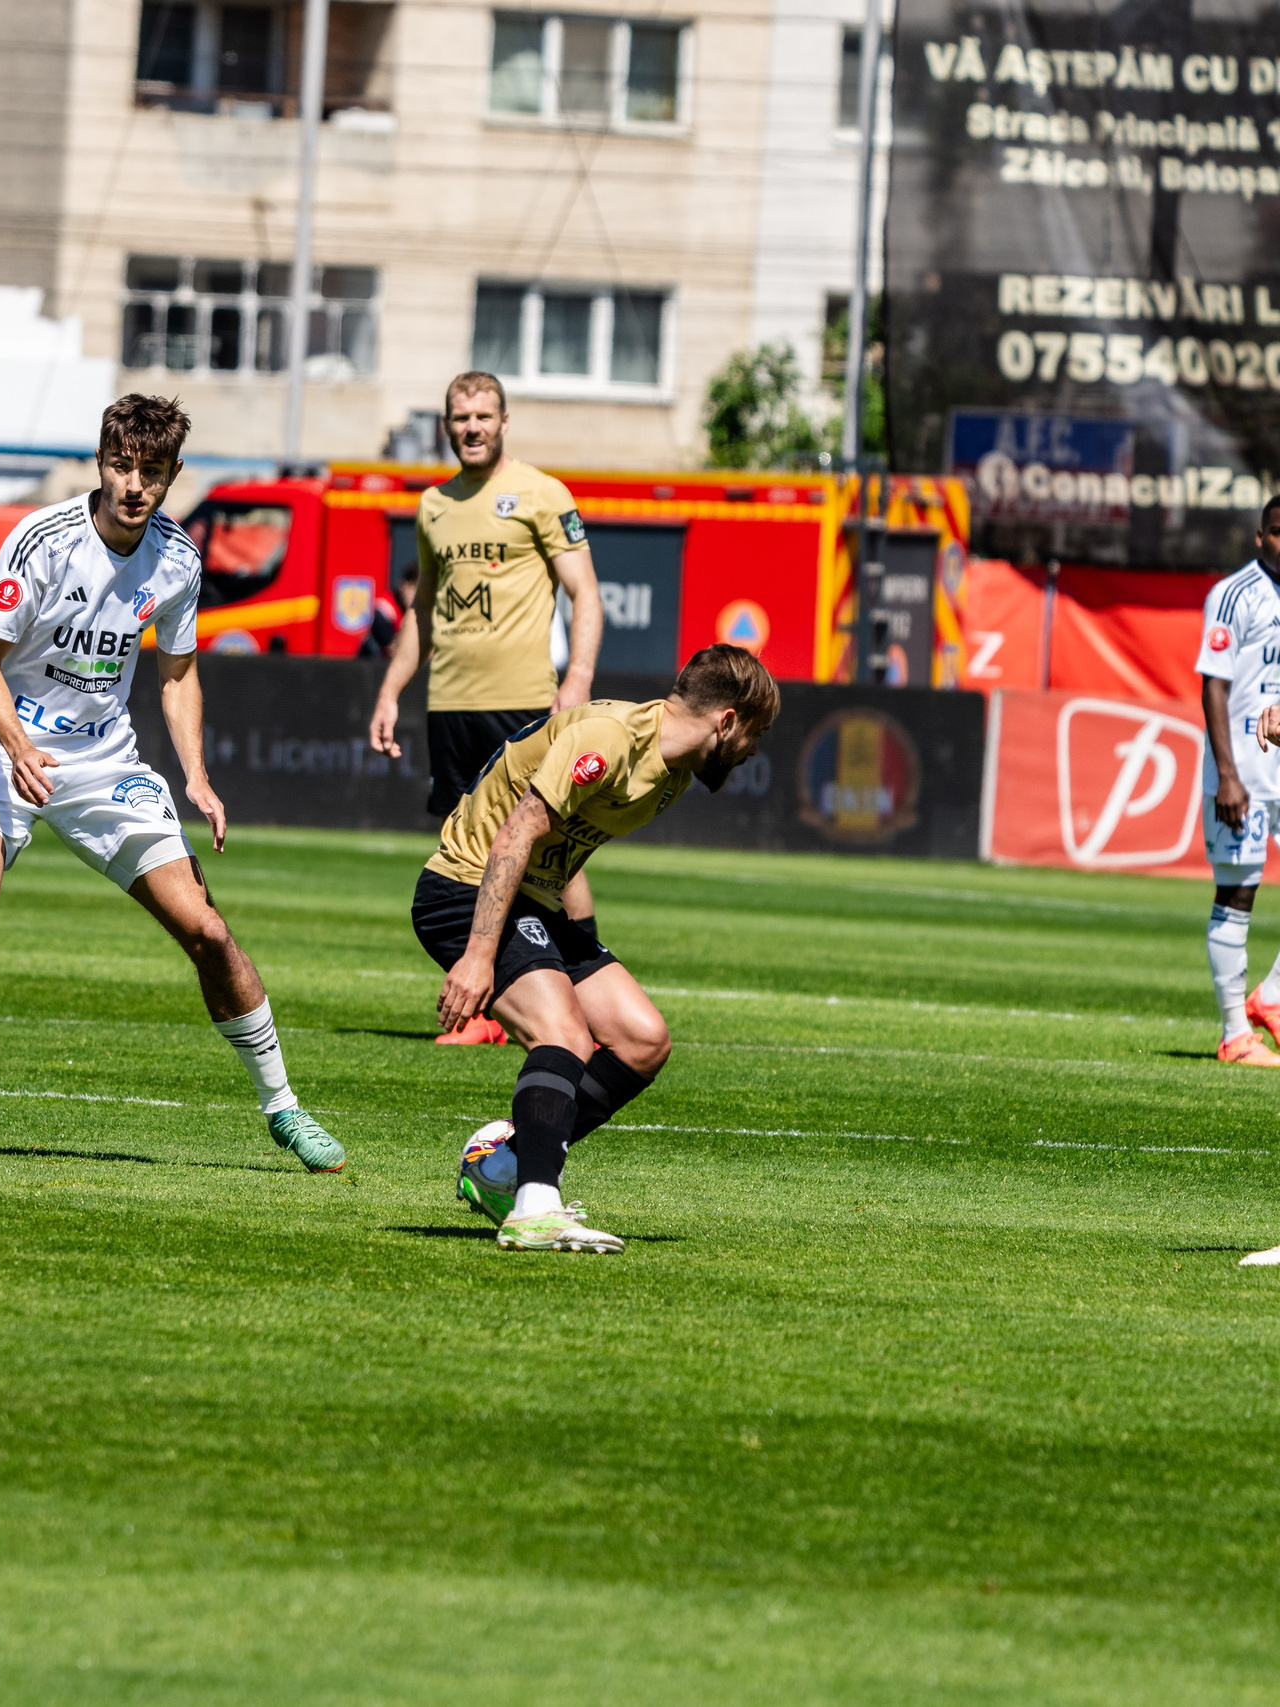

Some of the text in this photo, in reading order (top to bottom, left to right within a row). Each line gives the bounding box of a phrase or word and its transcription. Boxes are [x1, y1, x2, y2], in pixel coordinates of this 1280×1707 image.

[924, 37, 986, 83] VĂ
[1182, 54, 1239, 95] CU
[1000, 148, 1153, 197] Zăiceti,
[998, 273, 1244, 325] REZERVĂRI
